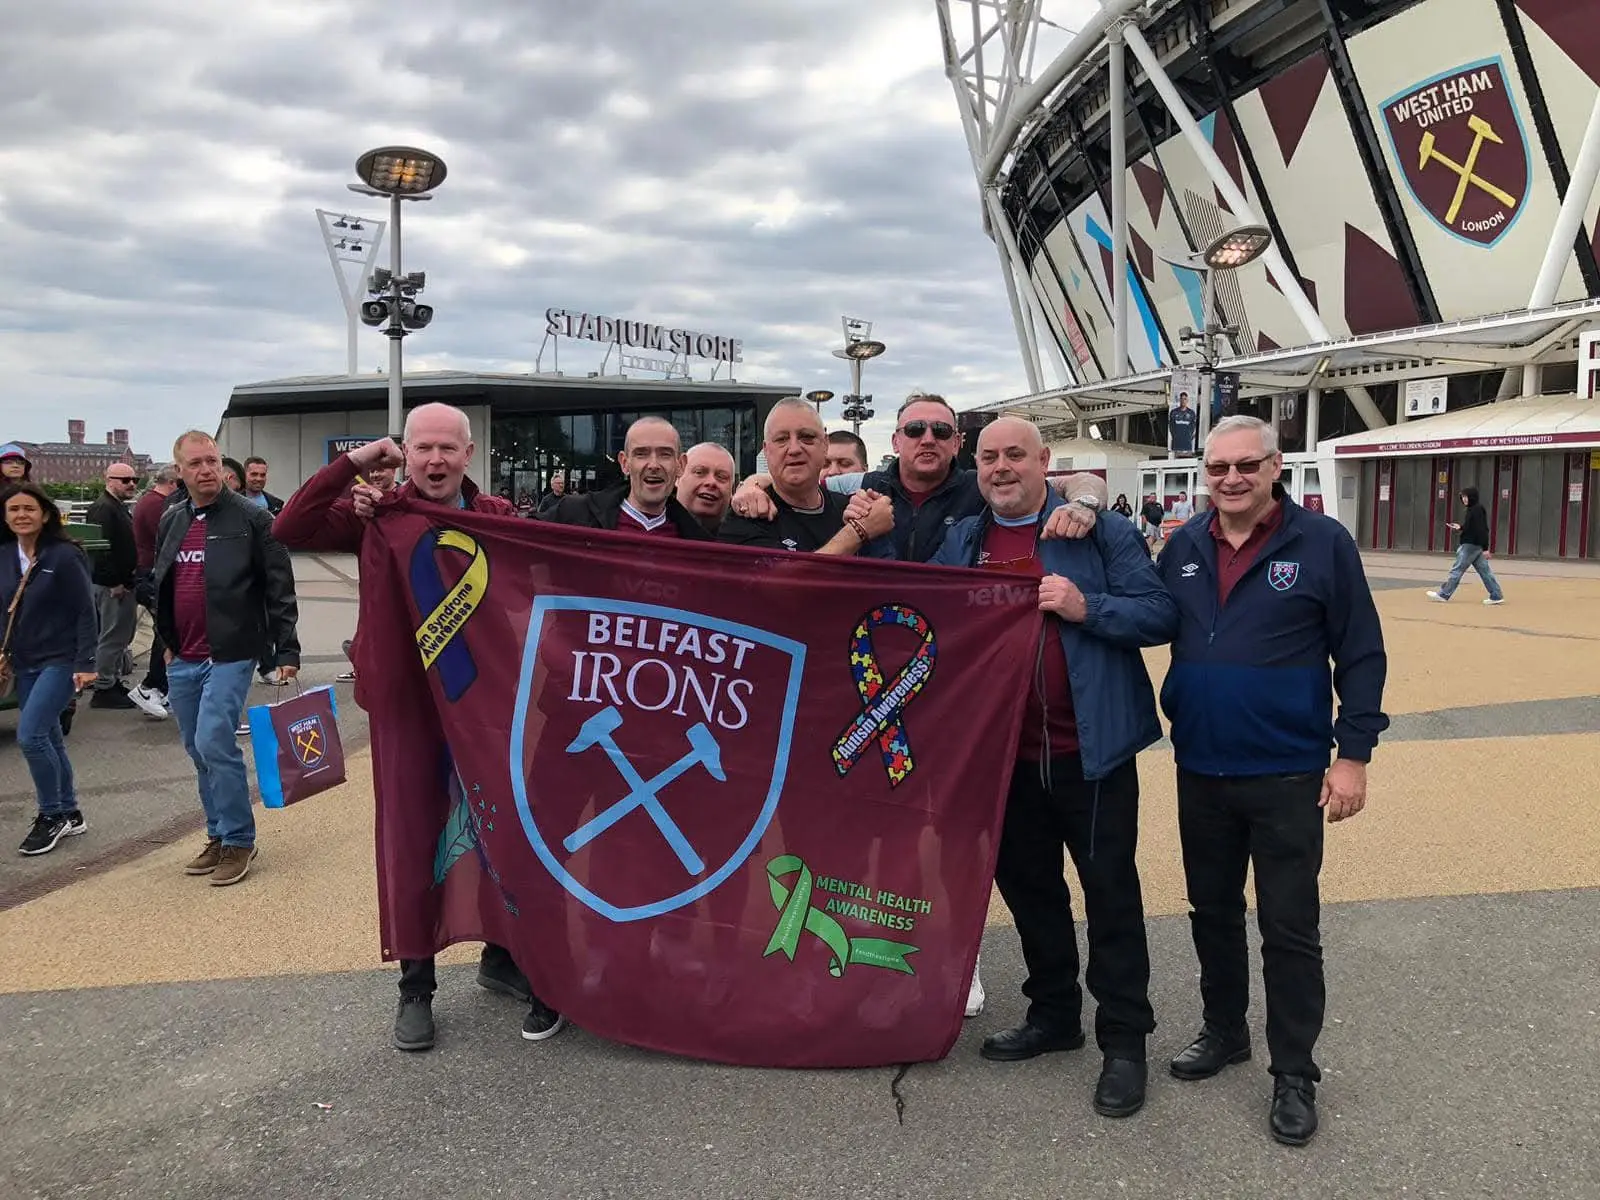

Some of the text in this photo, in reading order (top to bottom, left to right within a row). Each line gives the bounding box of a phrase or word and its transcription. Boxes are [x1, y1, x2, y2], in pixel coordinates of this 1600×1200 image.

[1393, 70, 1493, 123] WEST HAM
[1416, 96, 1474, 128] UNITED
[1462, 211, 1505, 232] LONDON
[545, 307, 744, 363] STADIUM STORE
[1280, 399, 1295, 420] 10
[175, 550, 205, 562] AVC
[422, 601, 473, 659] Awareness
[427, 582, 473, 632] Syndrome
[588, 613, 755, 670] BELFAST
[567, 651, 754, 730] IRONS
[838, 661, 928, 759] Autism Awareness
[816, 875, 932, 914] MENTAL HEALTH
[825, 898, 915, 931] AWARENESS
